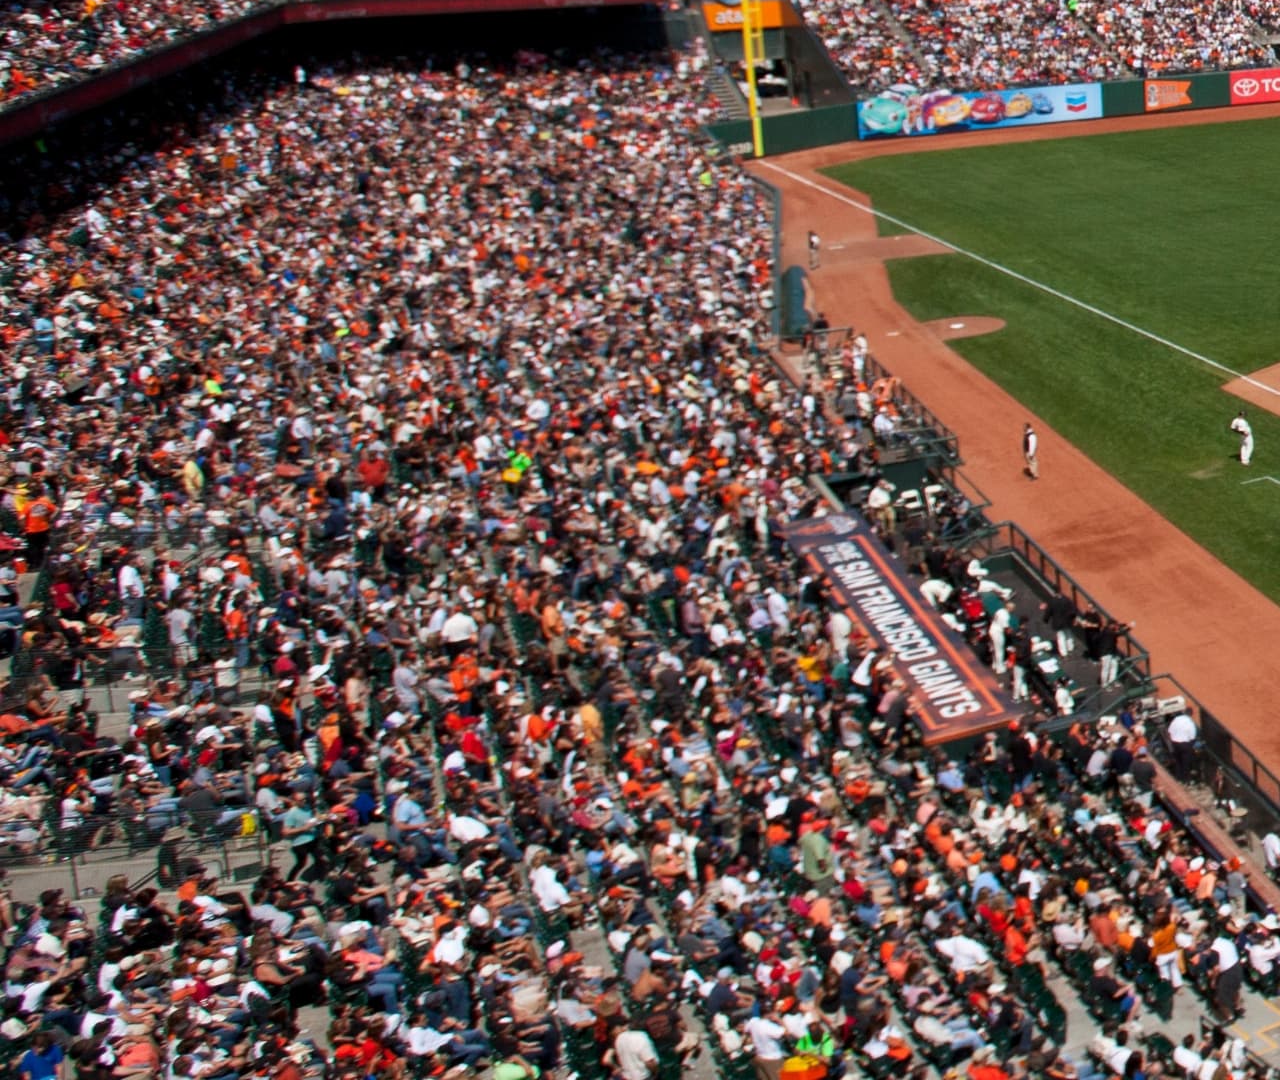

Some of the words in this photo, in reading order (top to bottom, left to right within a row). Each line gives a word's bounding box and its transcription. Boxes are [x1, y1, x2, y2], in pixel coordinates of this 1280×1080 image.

[833, 560, 882, 594] SAN
[852, 585, 938, 662] FRANCISCO
[907, 659, 982, 719] GIANTS
